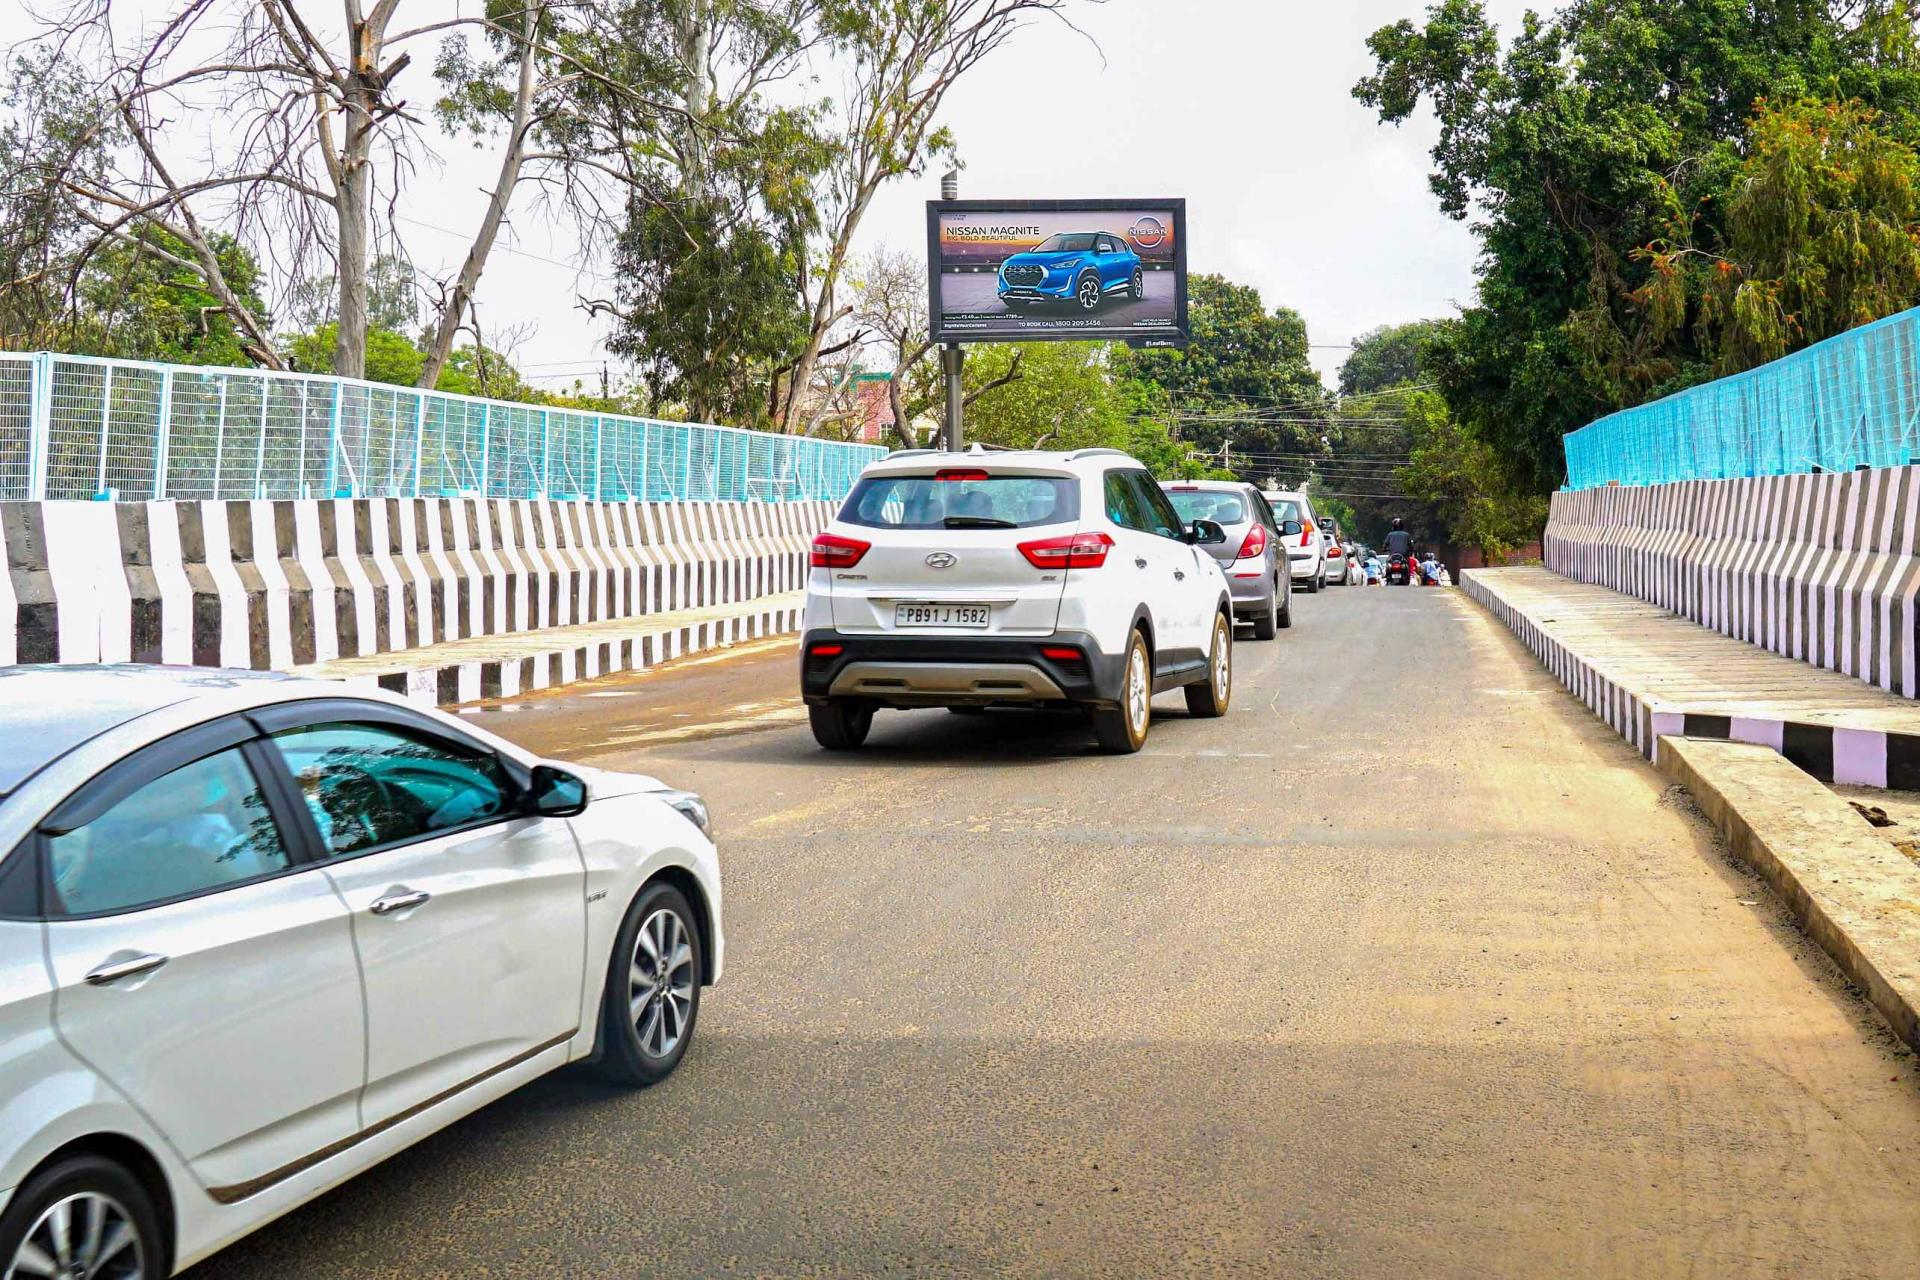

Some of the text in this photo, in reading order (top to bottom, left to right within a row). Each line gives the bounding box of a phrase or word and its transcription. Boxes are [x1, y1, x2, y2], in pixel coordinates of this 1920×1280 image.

[946, 226, 1040, 235] NISSAN MAGNITE
[906, 608, 938, 623] PB91
[942, 609, 950, 623] J
[955, 609, 986, 624] 1582
